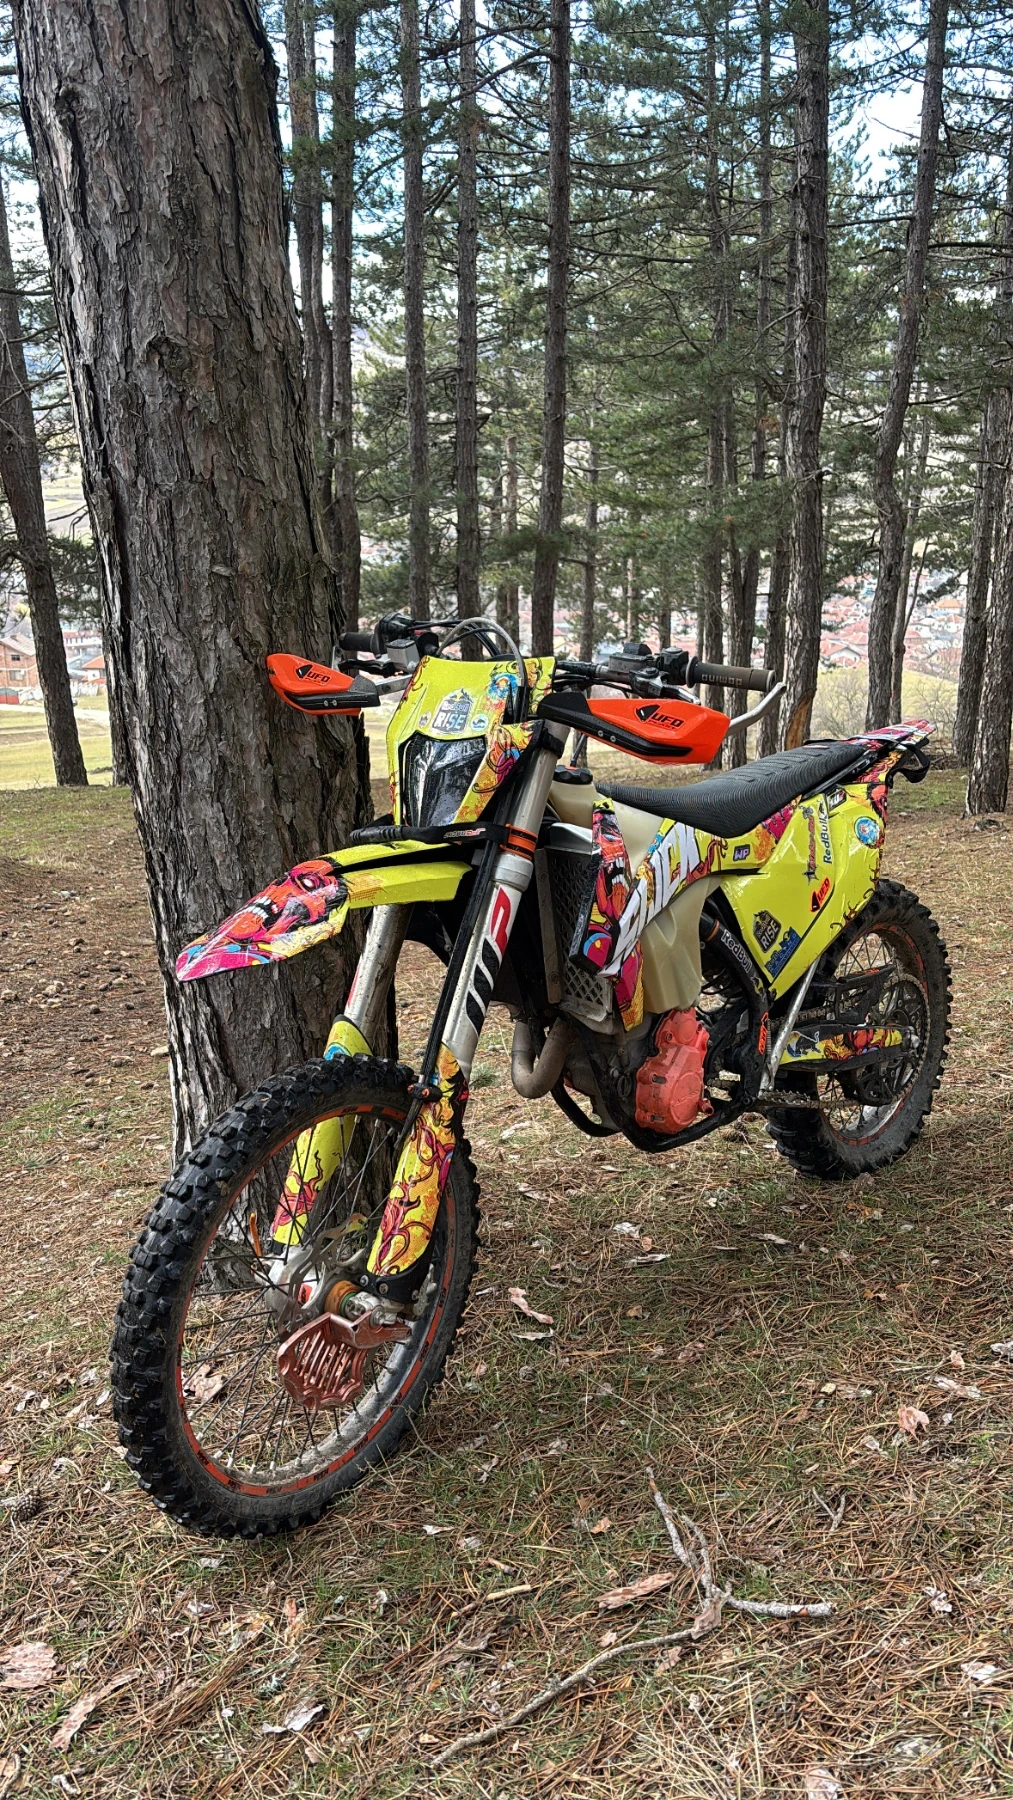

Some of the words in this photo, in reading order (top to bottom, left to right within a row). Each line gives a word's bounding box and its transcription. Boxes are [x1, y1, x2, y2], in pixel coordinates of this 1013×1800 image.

[307, 671, 330, 682] UFO
[702, 674, 743, 686] domino
[433, 711, 467, 730] RISE
[651, 713, 684, 727] UFO
[820, 816, 833, 865] RedBull
[734, 848, 750, 860] WP
[817, 878, 831, 903] UFO
[761, 920, 779, 949] RISE
[721, 929, 753, 974] RedBull
